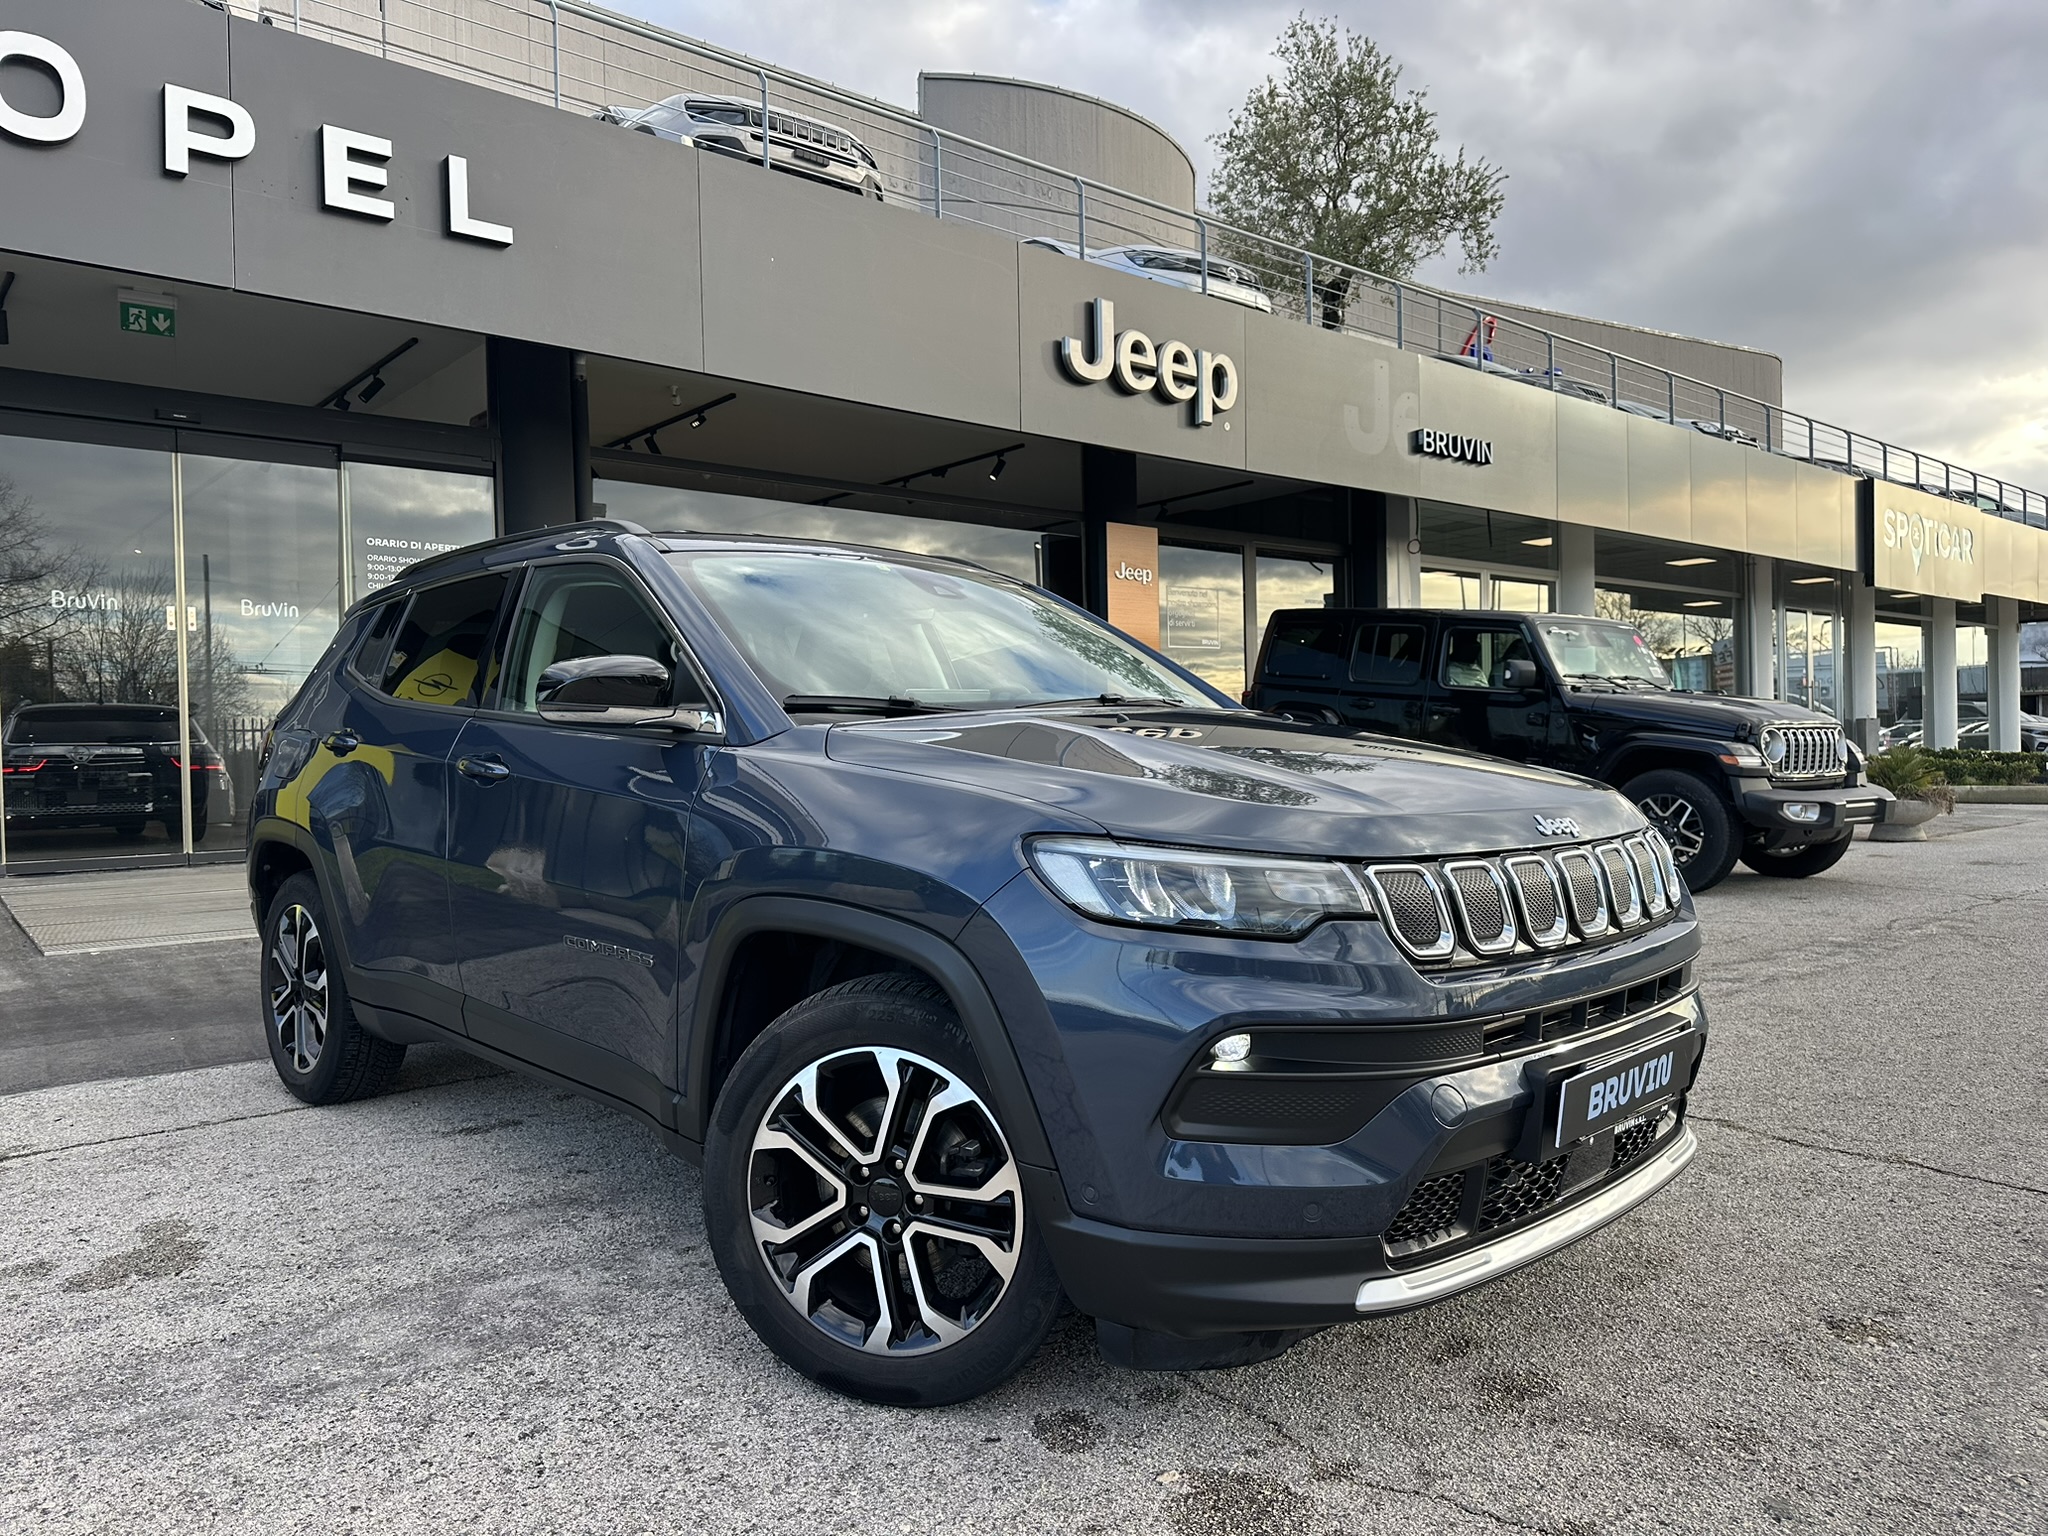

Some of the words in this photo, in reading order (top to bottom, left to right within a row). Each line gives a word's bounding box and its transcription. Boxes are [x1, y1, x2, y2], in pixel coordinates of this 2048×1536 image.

[0, 30, 514, 248] OPEL
[1062, 297, 1238, 426] Jeep
[1423, 428, 1494, 465] BRUVIN
[366, 537, 408, 549] ORARIO
[410, 541, 421, 550] DI
[367, 554, 397, 563] ORARIO
[1114, 562, 1153, 585] Jeep
[50, 589, 118, 611] BruVin
[240, 598, 299, 618] BruVin
[1533, 814, 1581, 838] Jeep
[563, 934, 654, 968] COMPASS
[1587, 1051, 1674, 1120] BRUVIN
